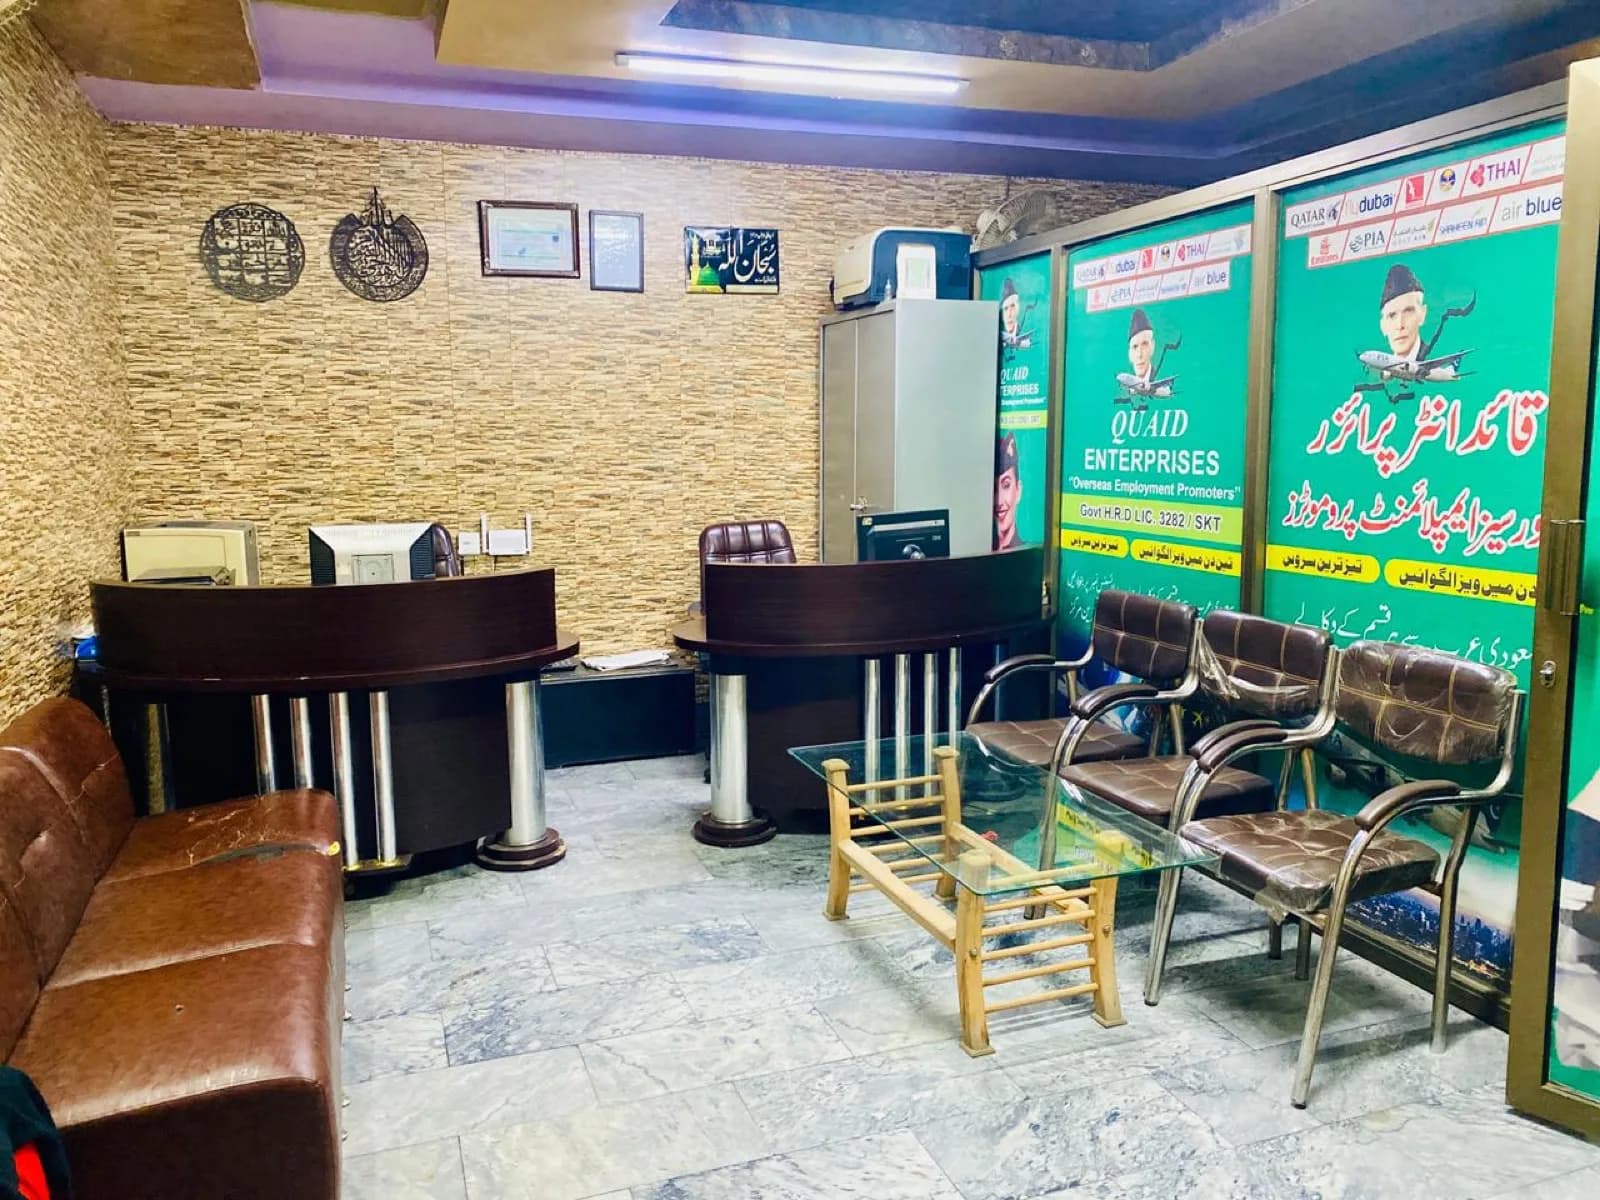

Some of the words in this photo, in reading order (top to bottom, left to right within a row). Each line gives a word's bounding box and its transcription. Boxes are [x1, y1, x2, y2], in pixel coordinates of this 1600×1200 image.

[1486, 157, 1521, 182] THAI
[1291, 207, 1326, 228] QATAR
[1364, 229, 1385, 249] PIA
[1206, 270, 1227, 286] blue
[1111, 409, 1189, 443] QUAID
[1084, 448, 1220, 476] ENTERPRISES
[1114, 478, 1175, 496] Employment
[1080, 503, 1101, 517] Govt
[1159, 511, 1185, 528] 3282
[1195, 515, 1221, 532] SKT
[1463, 508, 1541, 557] ورسیز
